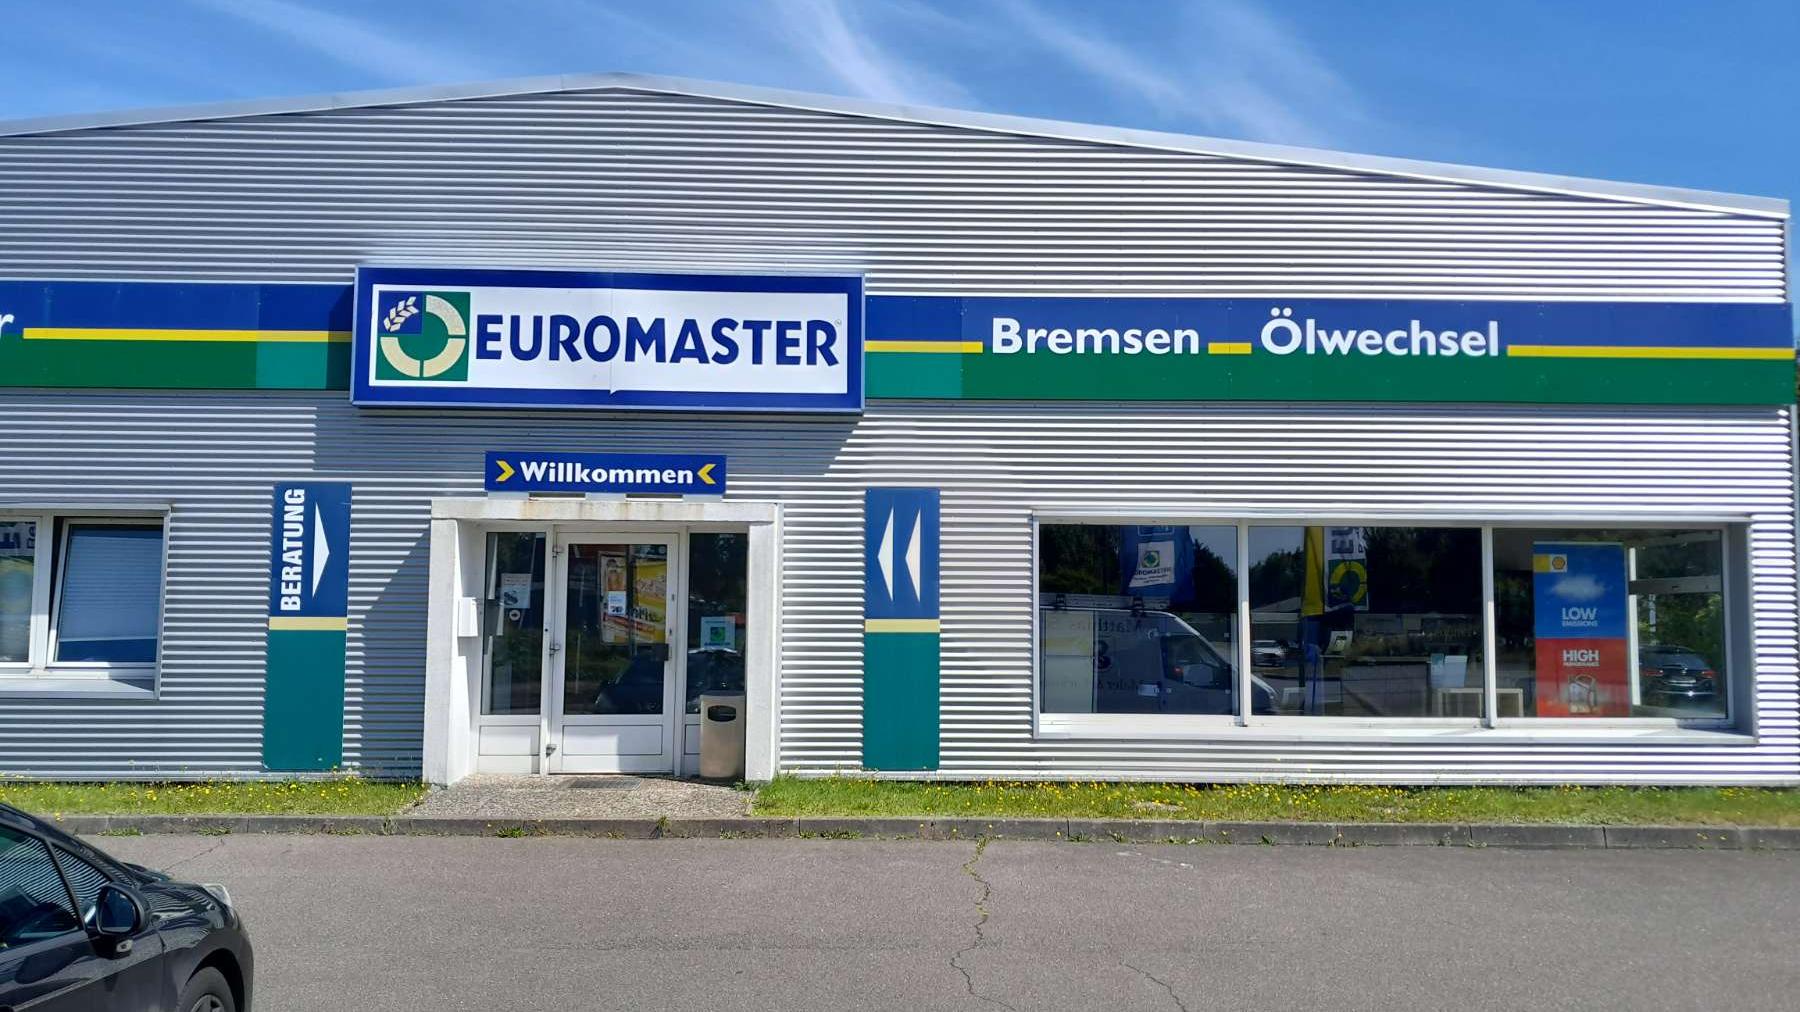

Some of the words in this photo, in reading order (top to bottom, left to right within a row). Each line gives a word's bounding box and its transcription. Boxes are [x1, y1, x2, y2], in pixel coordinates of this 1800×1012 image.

[475, 314, 839, 367] EUROMASTER
[992, 317, 1199, 355] Bremsen
[1260, 307, 1499, 356] Ölwechsel
[520, 461, 693, 484] Willkommen
[280, 488, 306, 612] BERATUNG
[1562, 607, 1598, 620] LOW
[1563, 649, 1599, 661] HIGH
